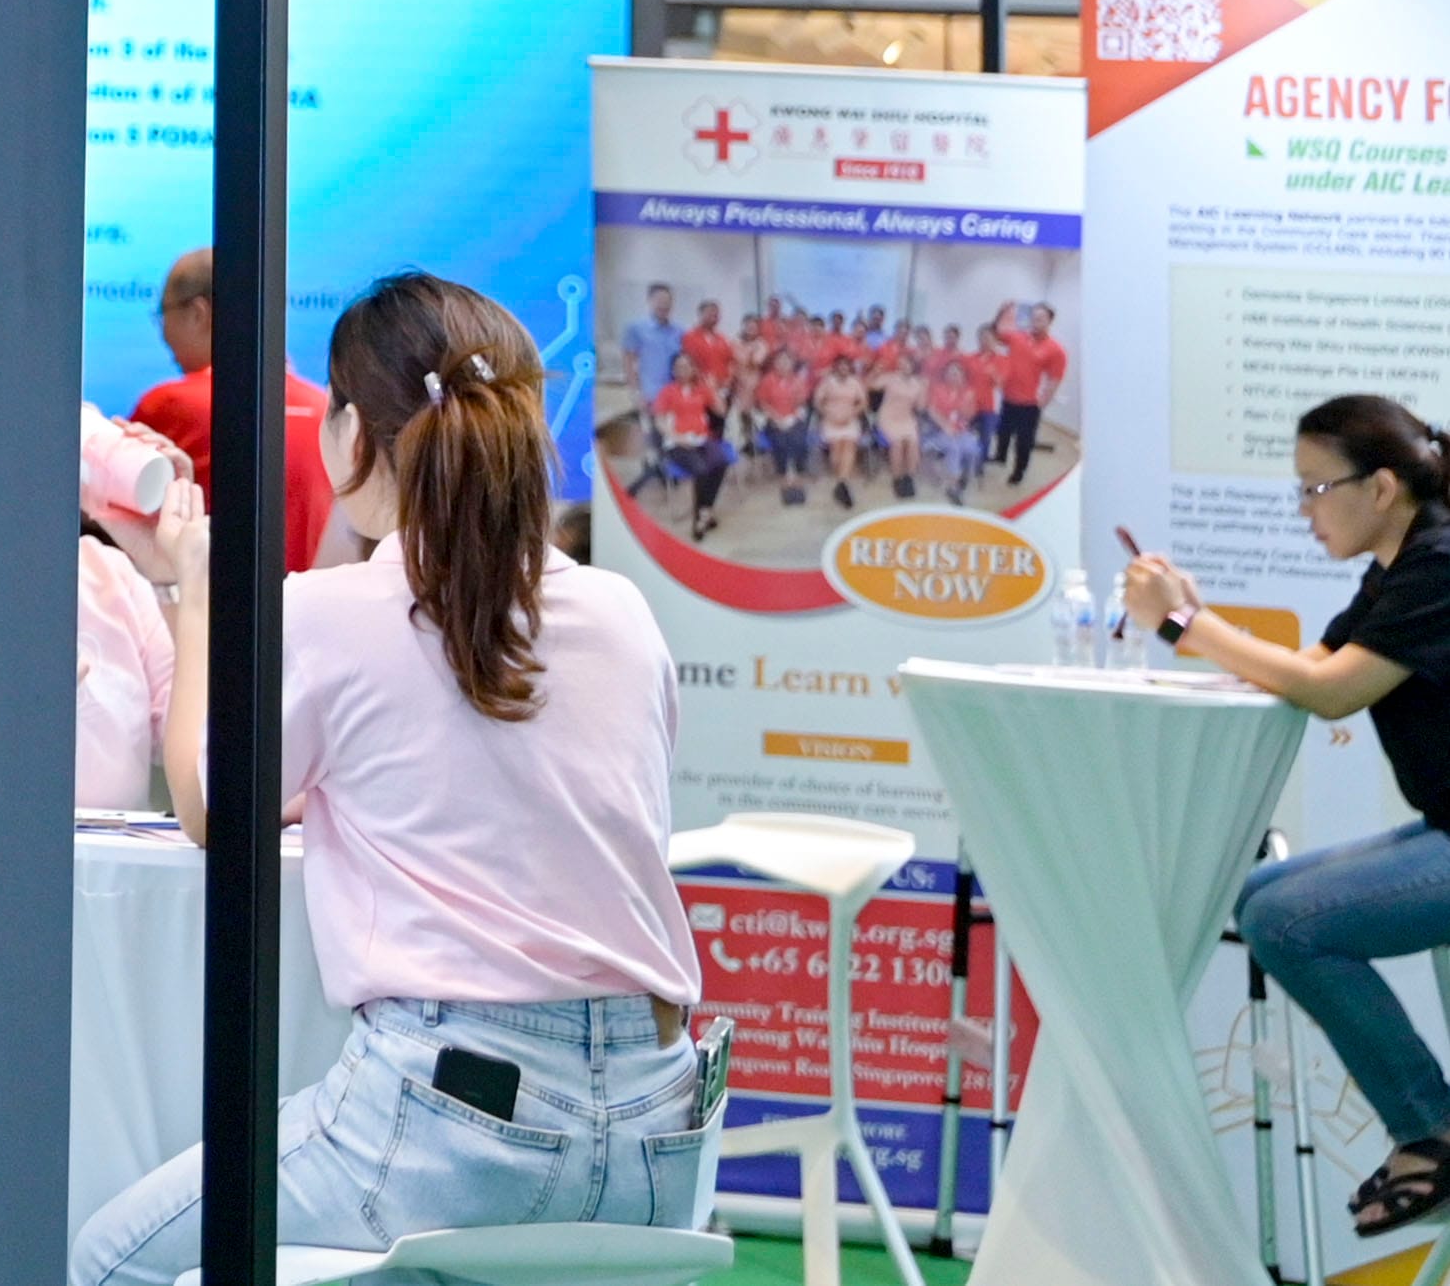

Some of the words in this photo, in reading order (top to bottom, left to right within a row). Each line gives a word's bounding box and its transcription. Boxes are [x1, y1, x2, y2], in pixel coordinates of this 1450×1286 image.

[1244, 75, 1409, 122] AGENCY
[1425, 80, 1450, 122] F
[1287, 137, 1341, 163] WSQ
[1348, 139, 1447, 165] Courses
[1285, 171, 1354, 195] under
[1363, 172, 1405, 195] AIC
[640, 197, 720, 228] Always
[724, 202, 868, 234] Professional,
[874, 211, 952, 241] Always
[961, 214, 1038, 244] Caring
[850, 538, 1036, 577] REGISTER
[893, 572, 990, 603] NOW
[754, 655, 870, 697] Learn
[707, 773, 770, 797] provider
[779, 775, 794, 792] of
[800, 778, 850, 797] choice
[856, 781, 874, 799] of
[747, 945, 798, 974] +65
[807, 951, 881, 983] 622
